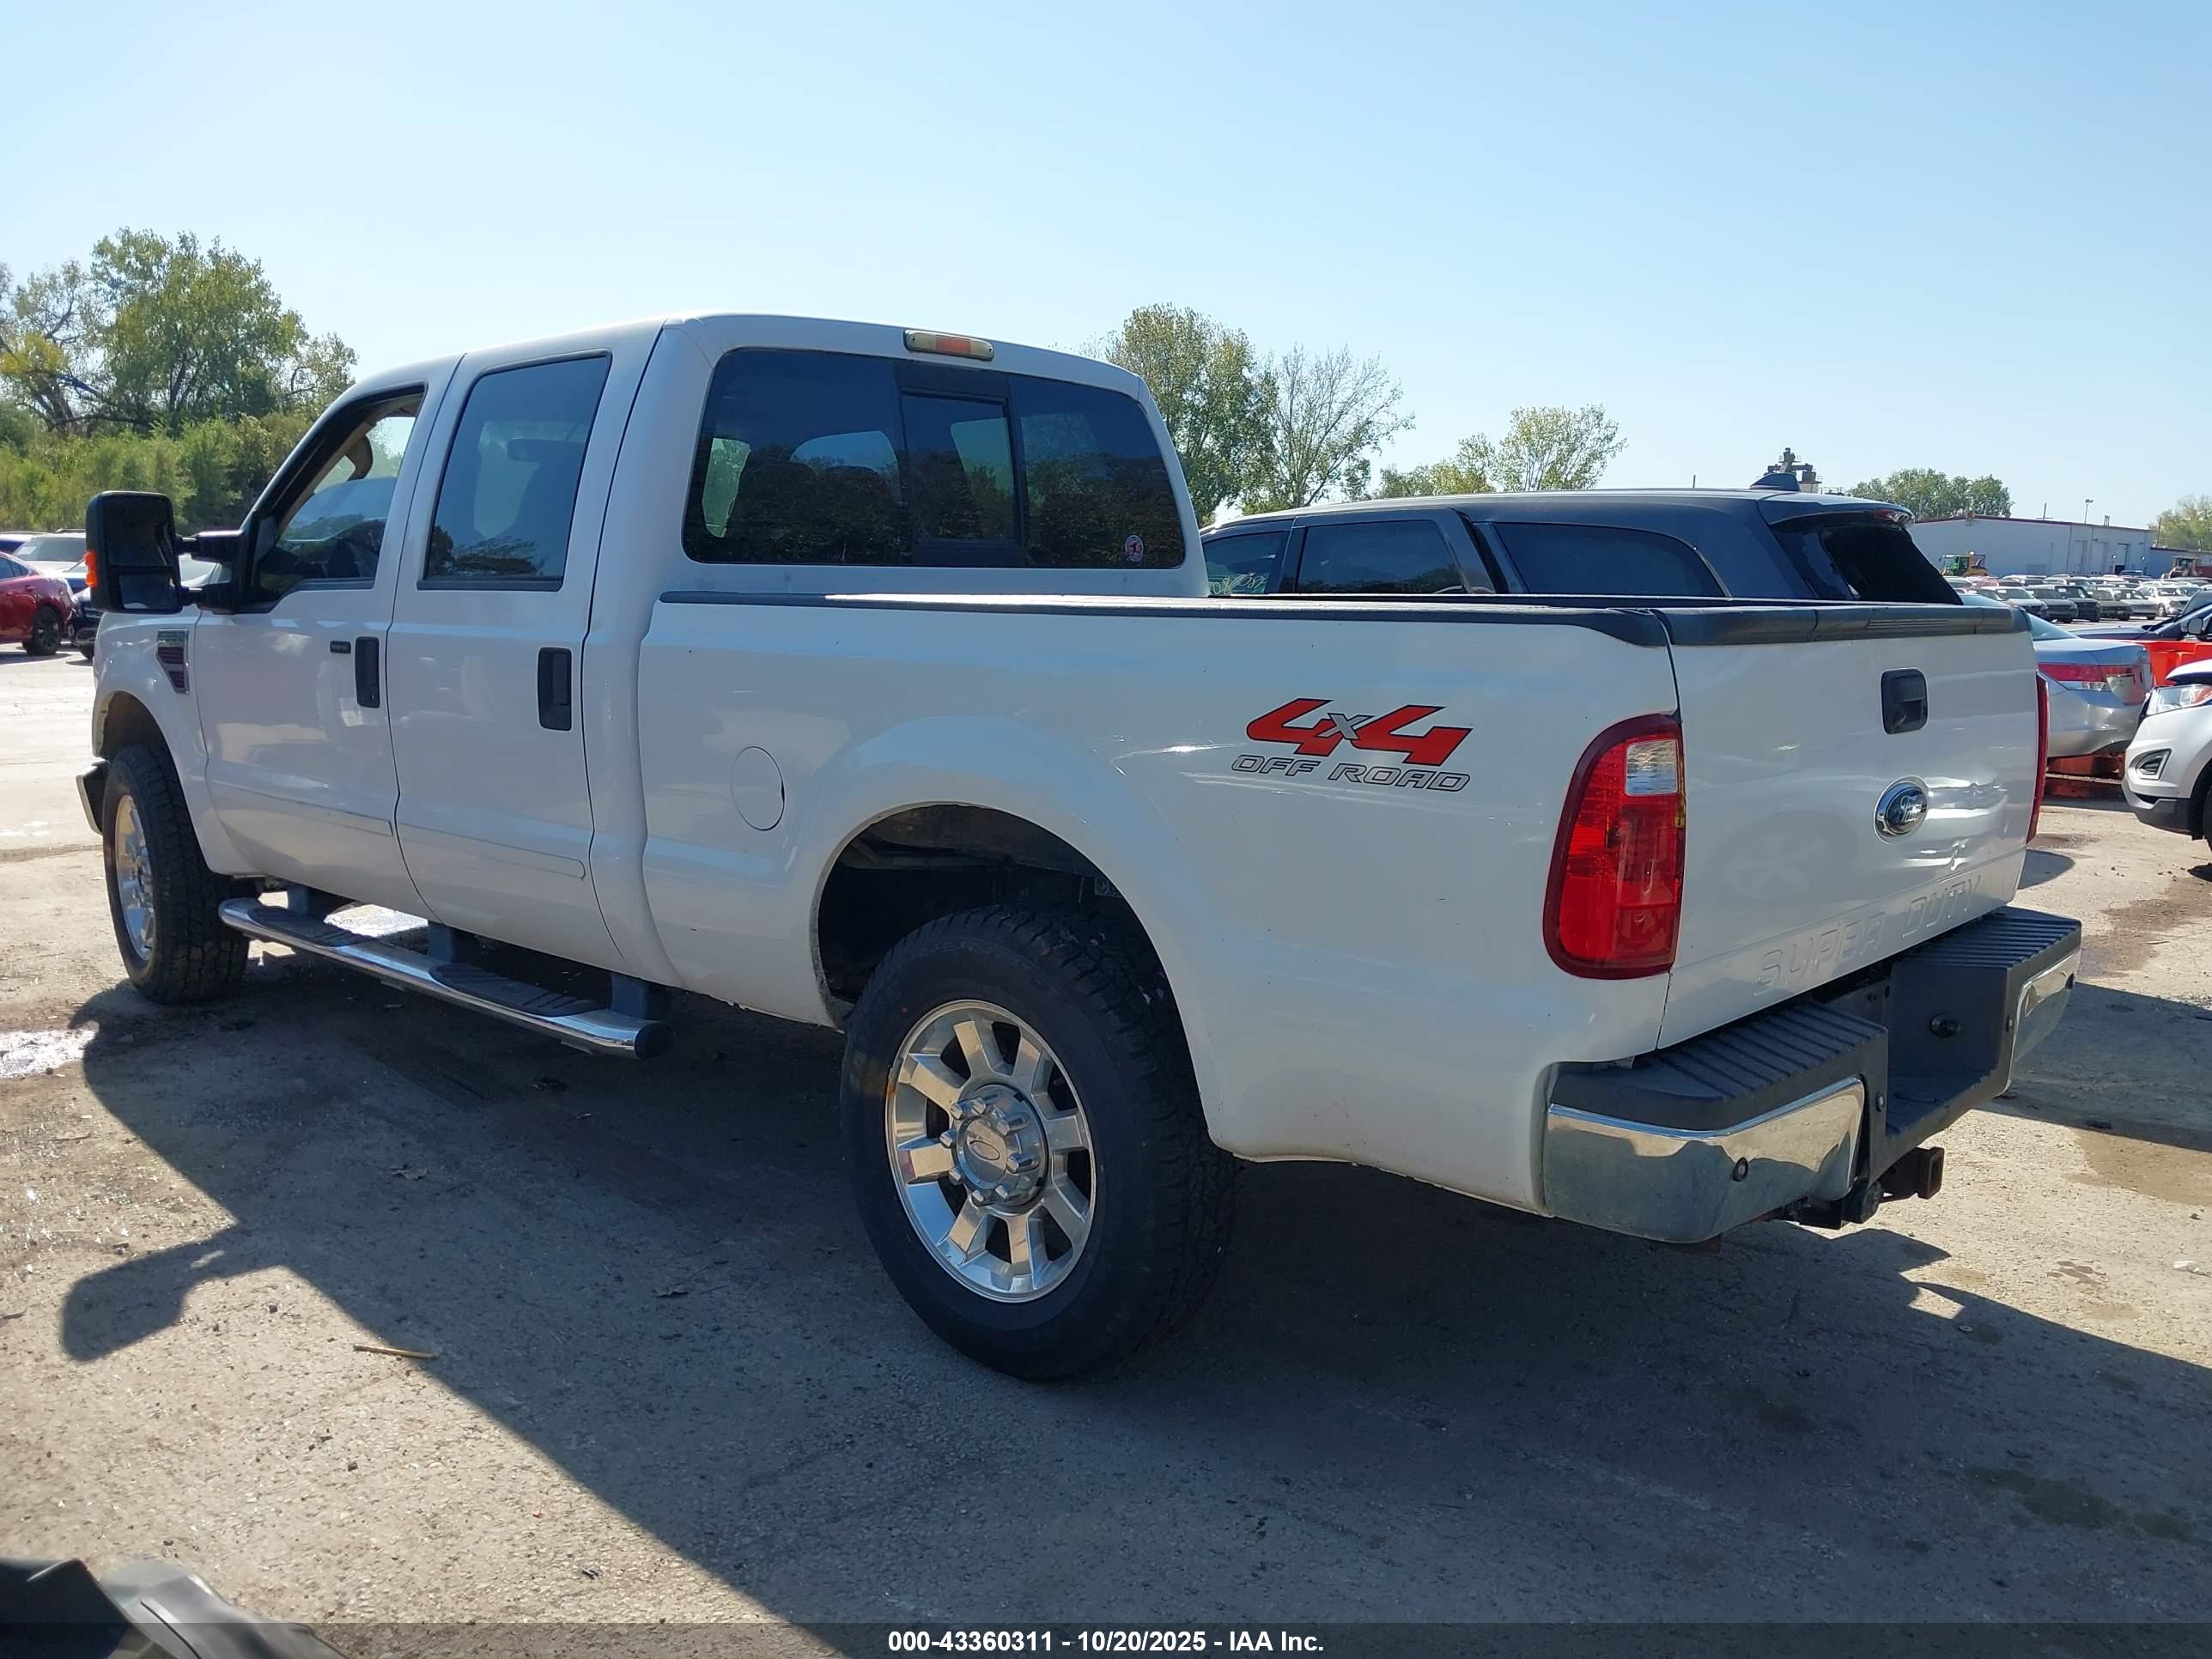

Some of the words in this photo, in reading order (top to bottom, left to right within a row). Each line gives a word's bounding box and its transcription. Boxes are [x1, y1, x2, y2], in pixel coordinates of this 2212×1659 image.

[1231, 754, 1322, 777] OFF
[1327, 763, 1471, 793] ROAD
[1753, 910, 1887, 997] SUPER
[1901, 874, 1982, 939] DUTY
